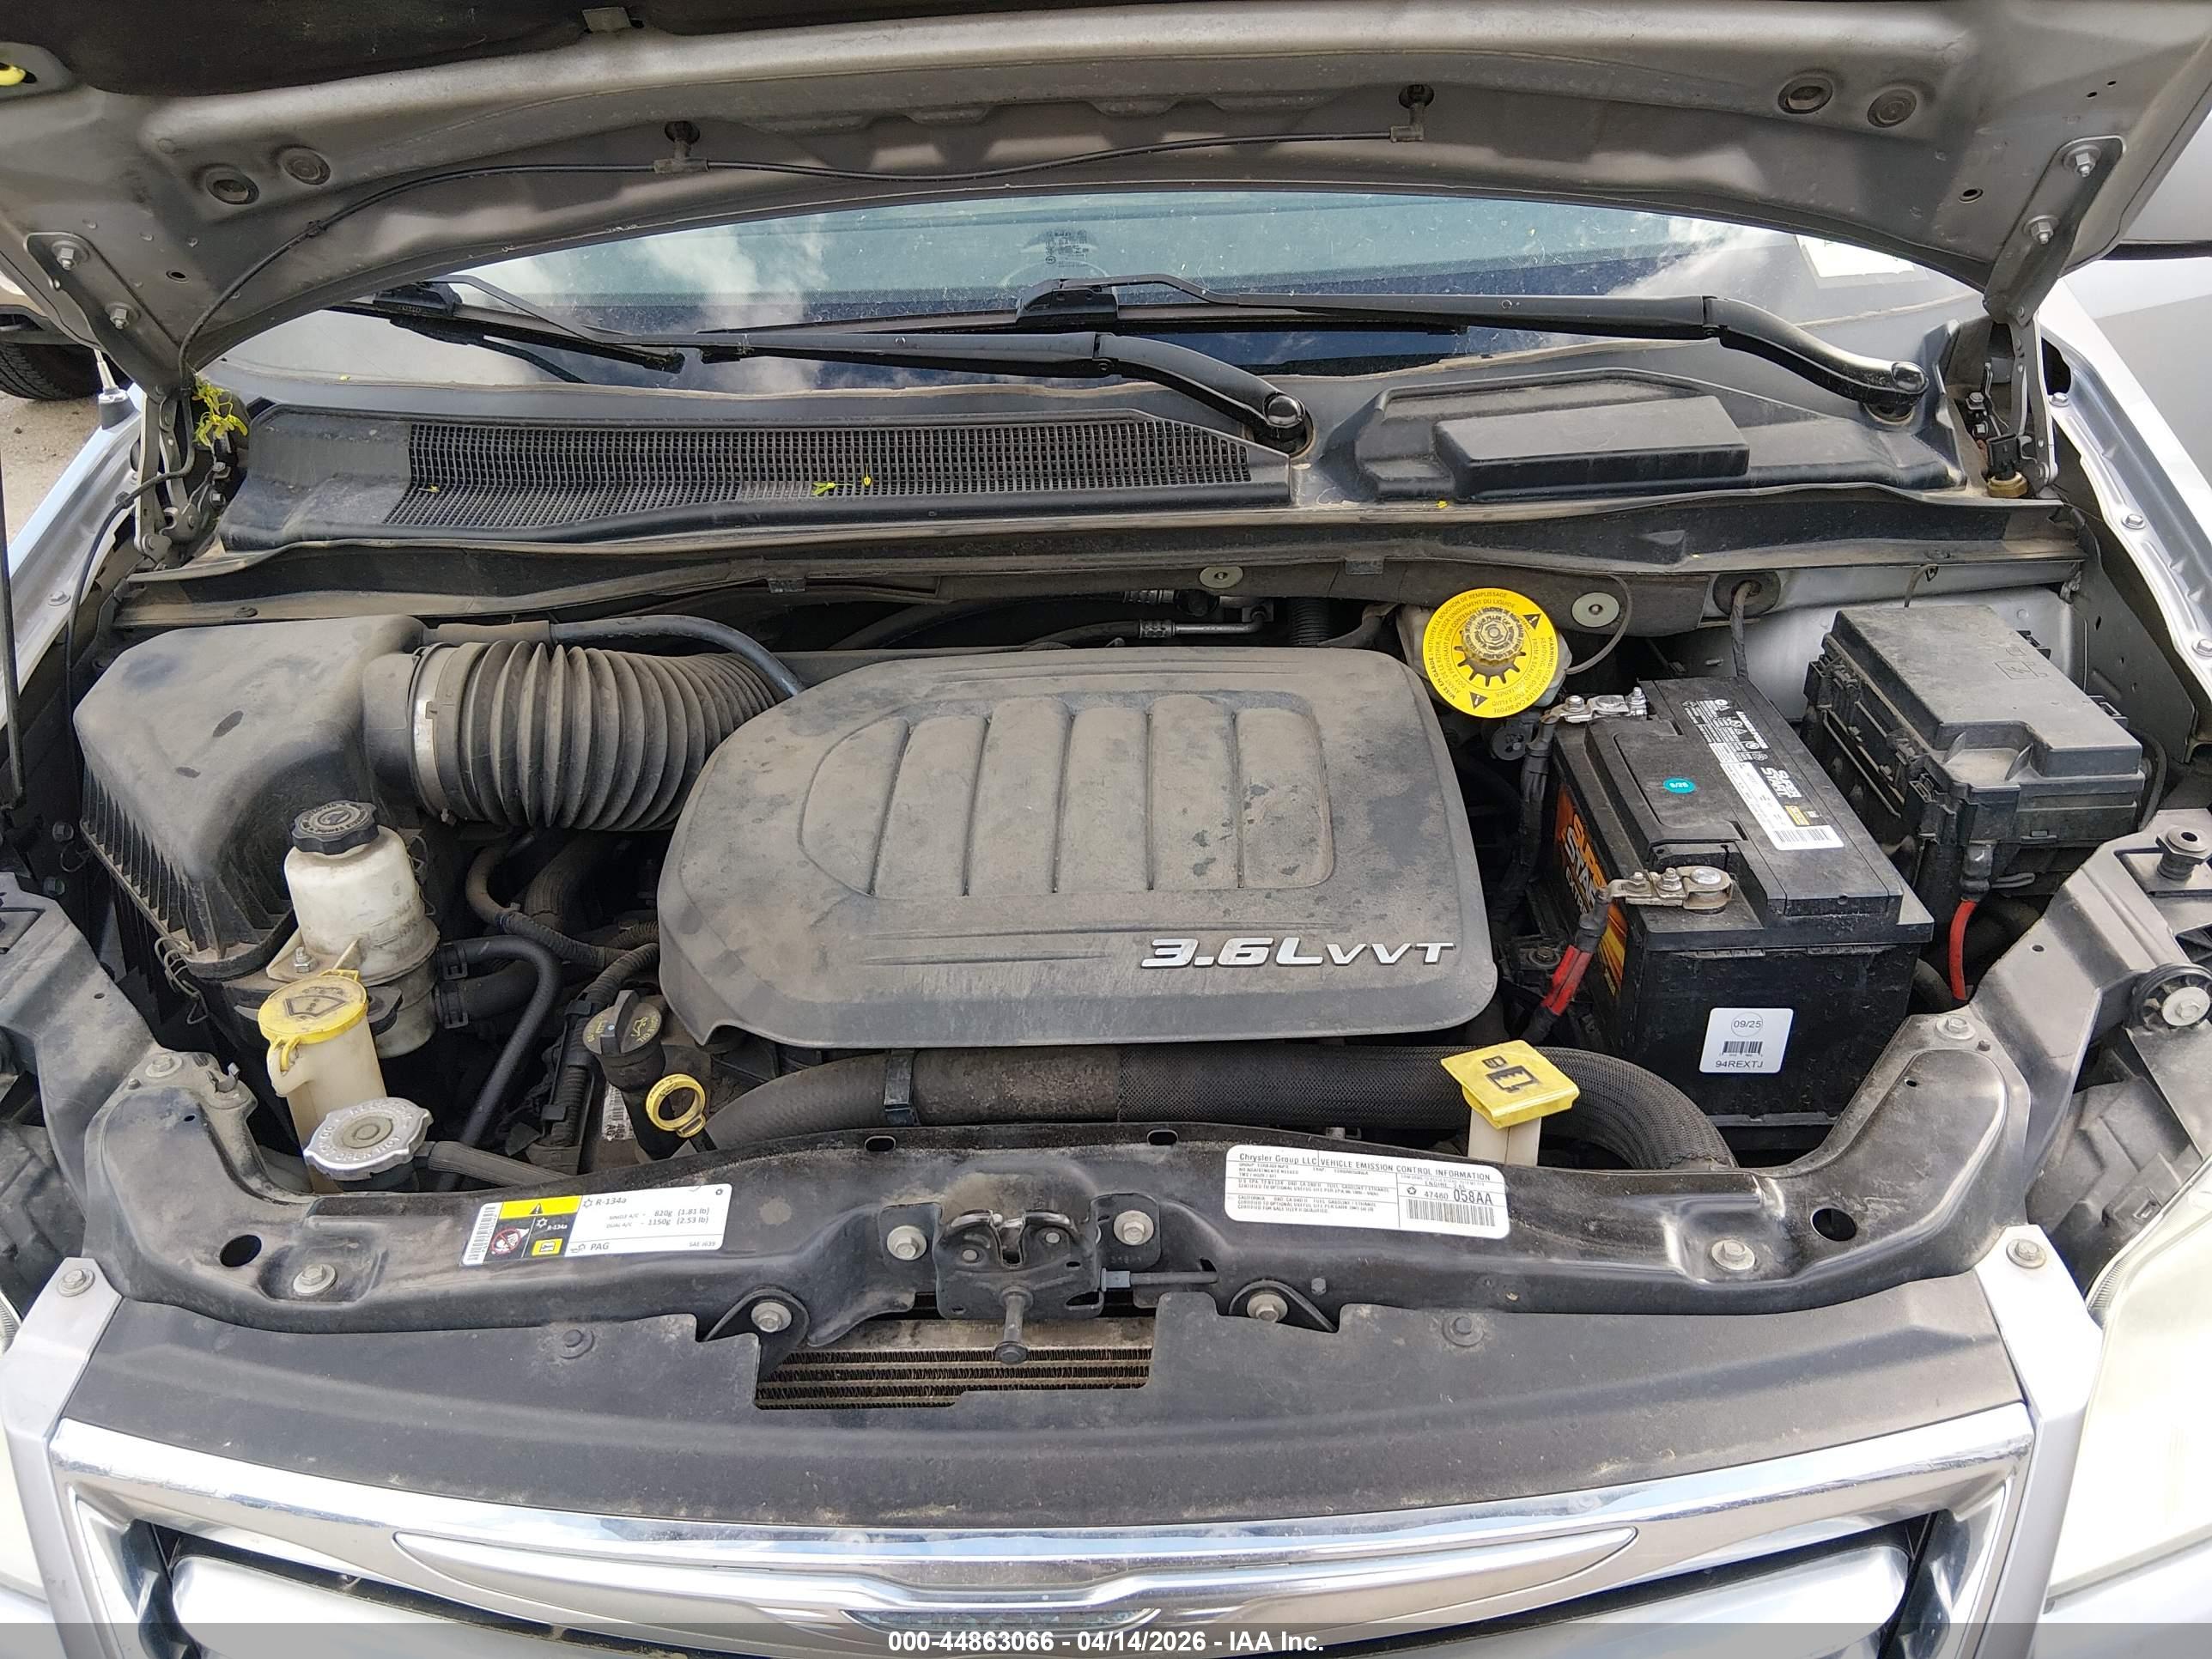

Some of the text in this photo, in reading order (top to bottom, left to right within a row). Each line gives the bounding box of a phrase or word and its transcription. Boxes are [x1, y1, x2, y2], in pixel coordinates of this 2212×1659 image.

[1760, 767, 1793, 799] START
[1733, 1020, 1762, 1029] 09/25
[1715, 1060, 1764, 1069] 94REXTJ
[1239, 1152, 1272, 1164] Chrysler
[1274, 1154, 1299, 1165] Group
[1302, 1157, 1317, 1165] LLC
[1321, 1158, 1352, 1169] VEHICLE
[1356, 1161, 1394, 1171] EMISSION
[1396, 1164, 1432, 1176] CONTROL
[1435, 1169, 1491, 1182] INFORMATION
[595, 1196, 627, 1206] R-134a
[1454, 1189, 1493, 1205] 058AA
[653, 1209, 673, 1218] 820g
[699, 1206, 710, 1216] lb)
[647, 1218, 671, 1226] 1150g
[676, 1217, 696, 1225] (2.53
[698, 1215, 709, 1224] lb)
[590, 1242, 610, 1251] PAG
[689, 1240, 701, 1249] SAE
